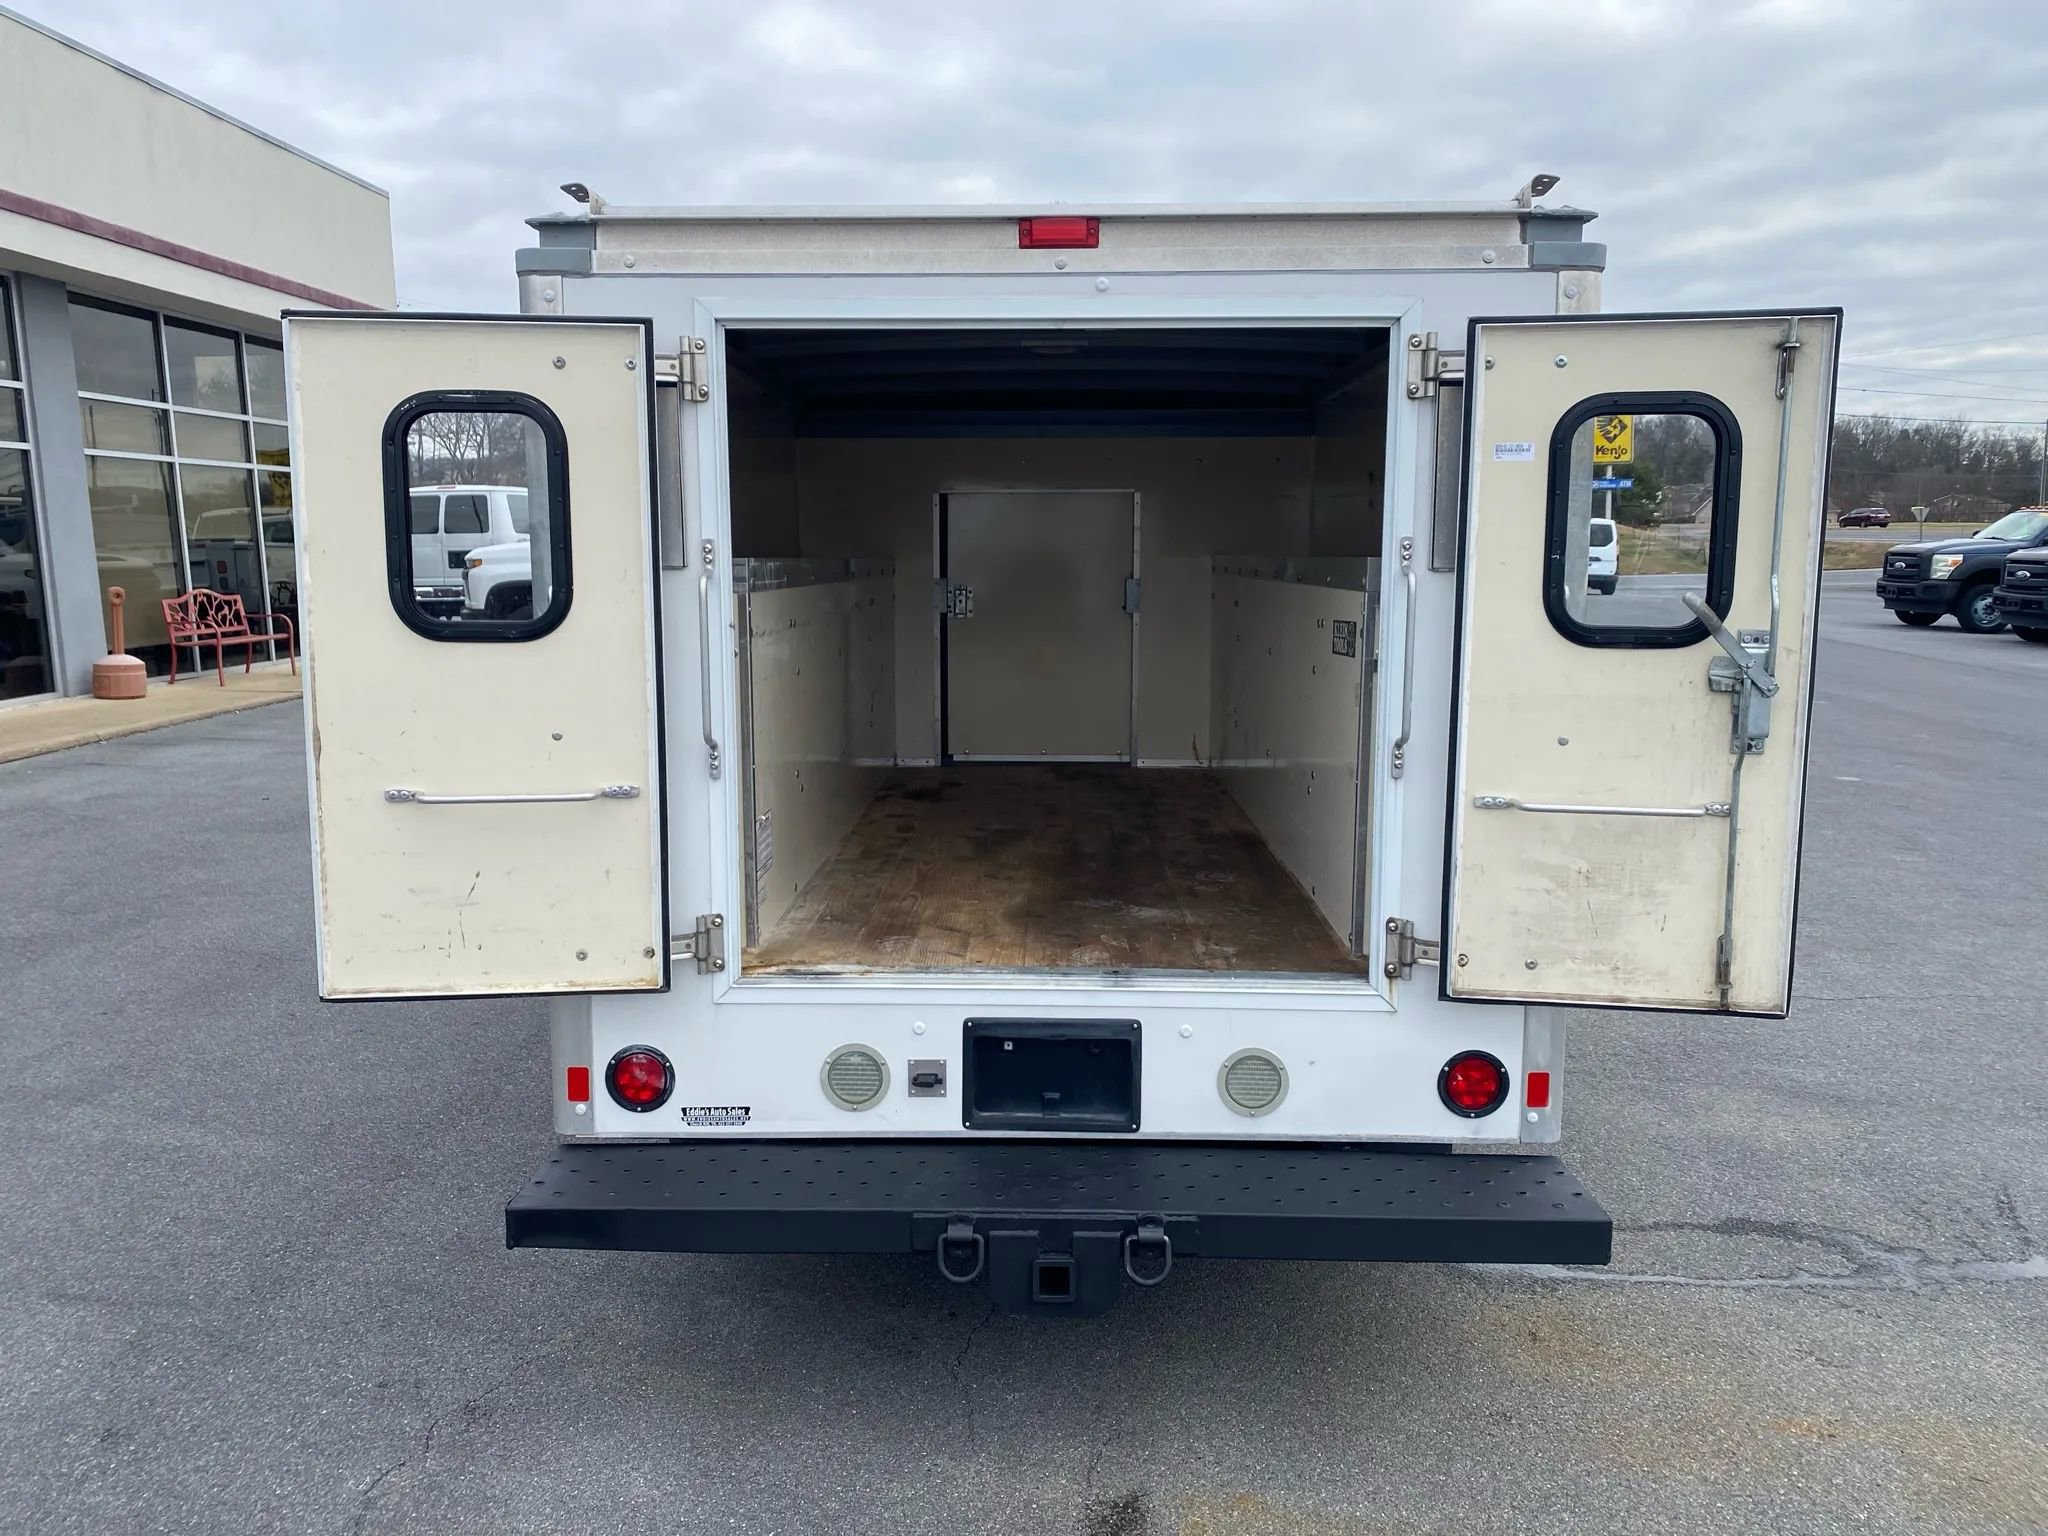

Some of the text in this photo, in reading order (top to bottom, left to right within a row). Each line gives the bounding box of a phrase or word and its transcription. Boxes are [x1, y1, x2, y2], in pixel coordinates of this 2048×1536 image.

[1596, 445, 1628, 459] Kenjo
[1619, 480, 1632, 488] ATM
[687, 1107, 746, 1116] Eddie's Auto Sales
